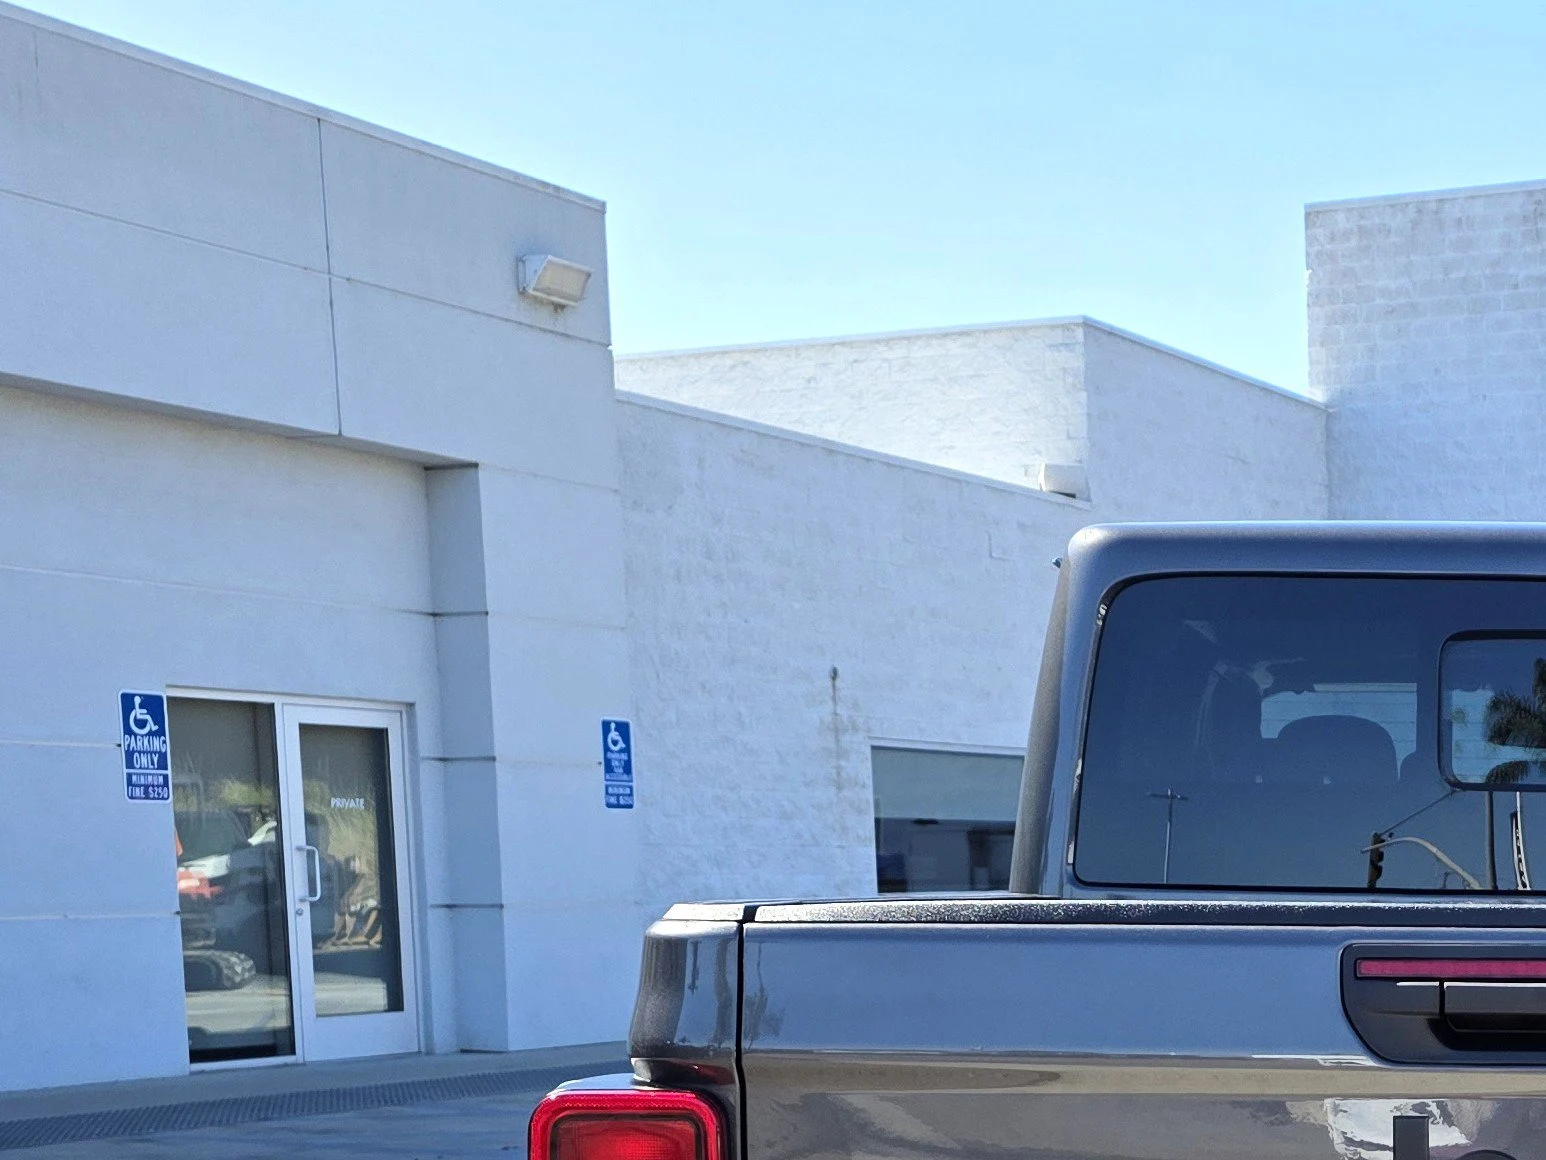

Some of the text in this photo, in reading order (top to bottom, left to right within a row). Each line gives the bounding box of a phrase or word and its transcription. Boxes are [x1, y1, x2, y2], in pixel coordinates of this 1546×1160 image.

[124, 734, 167, 753] PARKING
[133, 752, 159, 769] ONLY
[131, 774, 164, 785] MINIMUM
[148, 786, 169, 799] $250
[330, 796, 365, 810] PRIVATE
